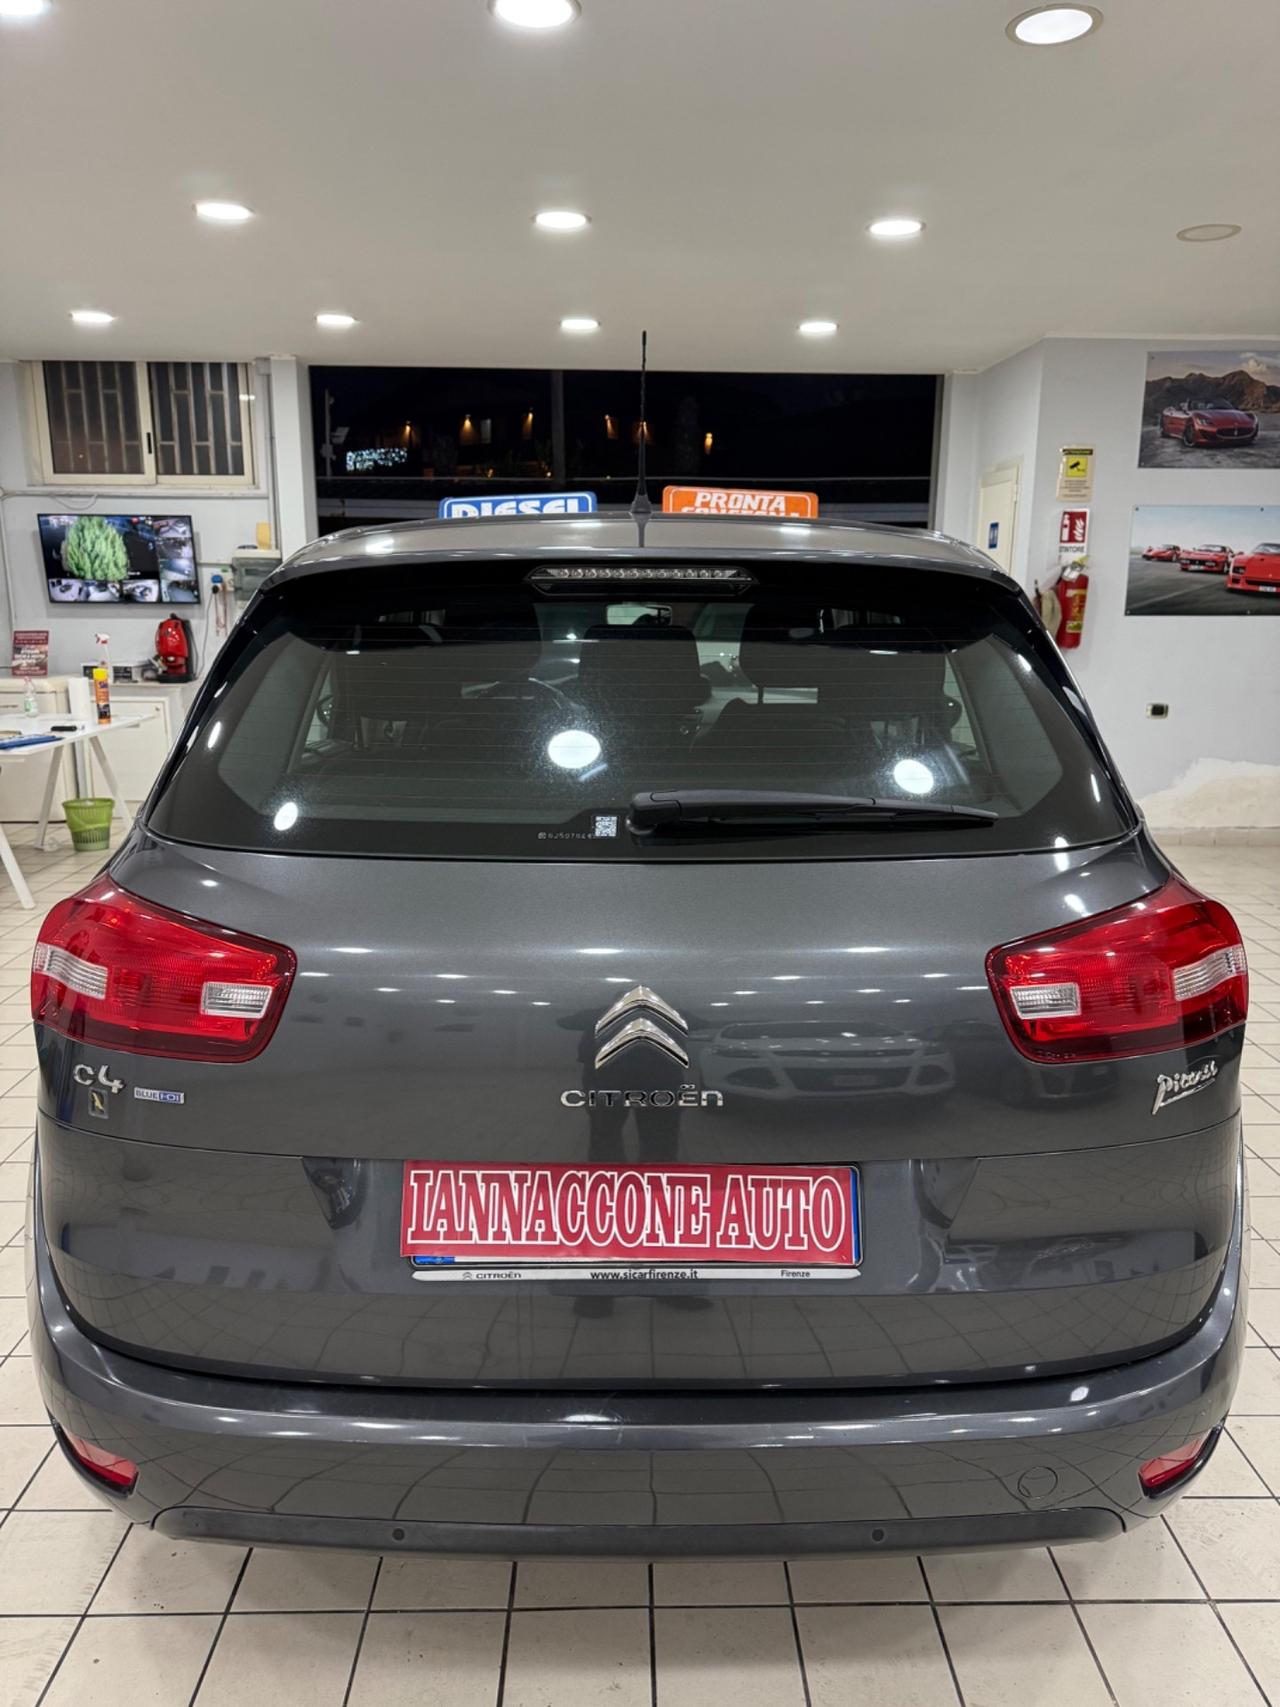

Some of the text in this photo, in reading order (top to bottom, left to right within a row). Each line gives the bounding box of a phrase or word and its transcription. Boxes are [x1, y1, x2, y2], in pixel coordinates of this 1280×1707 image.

[695, 492, 786, 511] PRONTA
[73, 1064, 125, 1094] C4
[407, 1170, 846, 1252] IANNACCONE AUTO
[590, 1268, 698, 1280] www.sicarfirenze.it
[780, 1269, 811, 1279] Firenze
